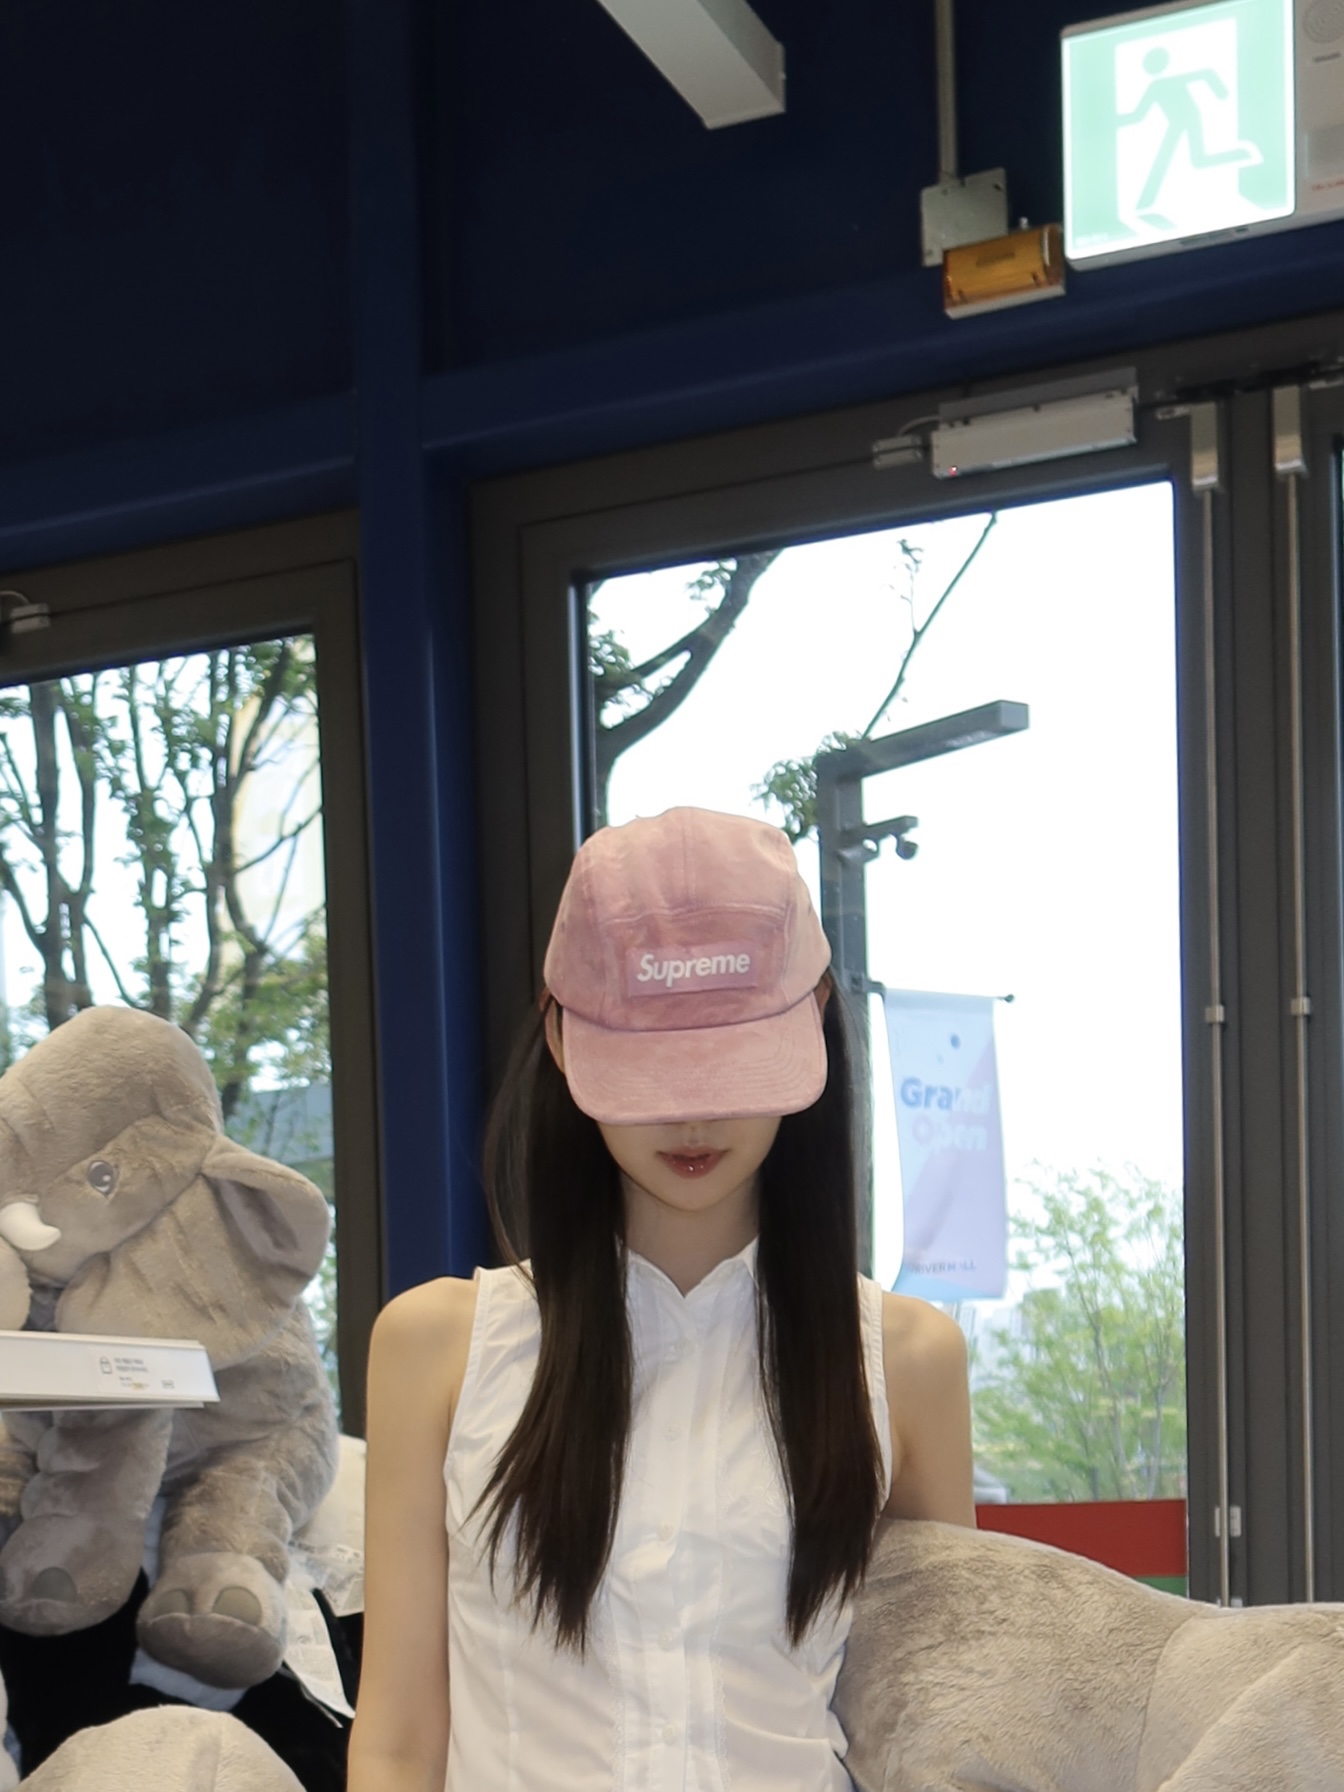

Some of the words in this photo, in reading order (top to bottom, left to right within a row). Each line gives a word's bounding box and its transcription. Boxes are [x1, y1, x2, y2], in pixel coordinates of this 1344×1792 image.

[636, 952, 751, 988] Supreme
[900, 1077, 992, 1115] Grand
[912, 1115, 988, 1155] Open
